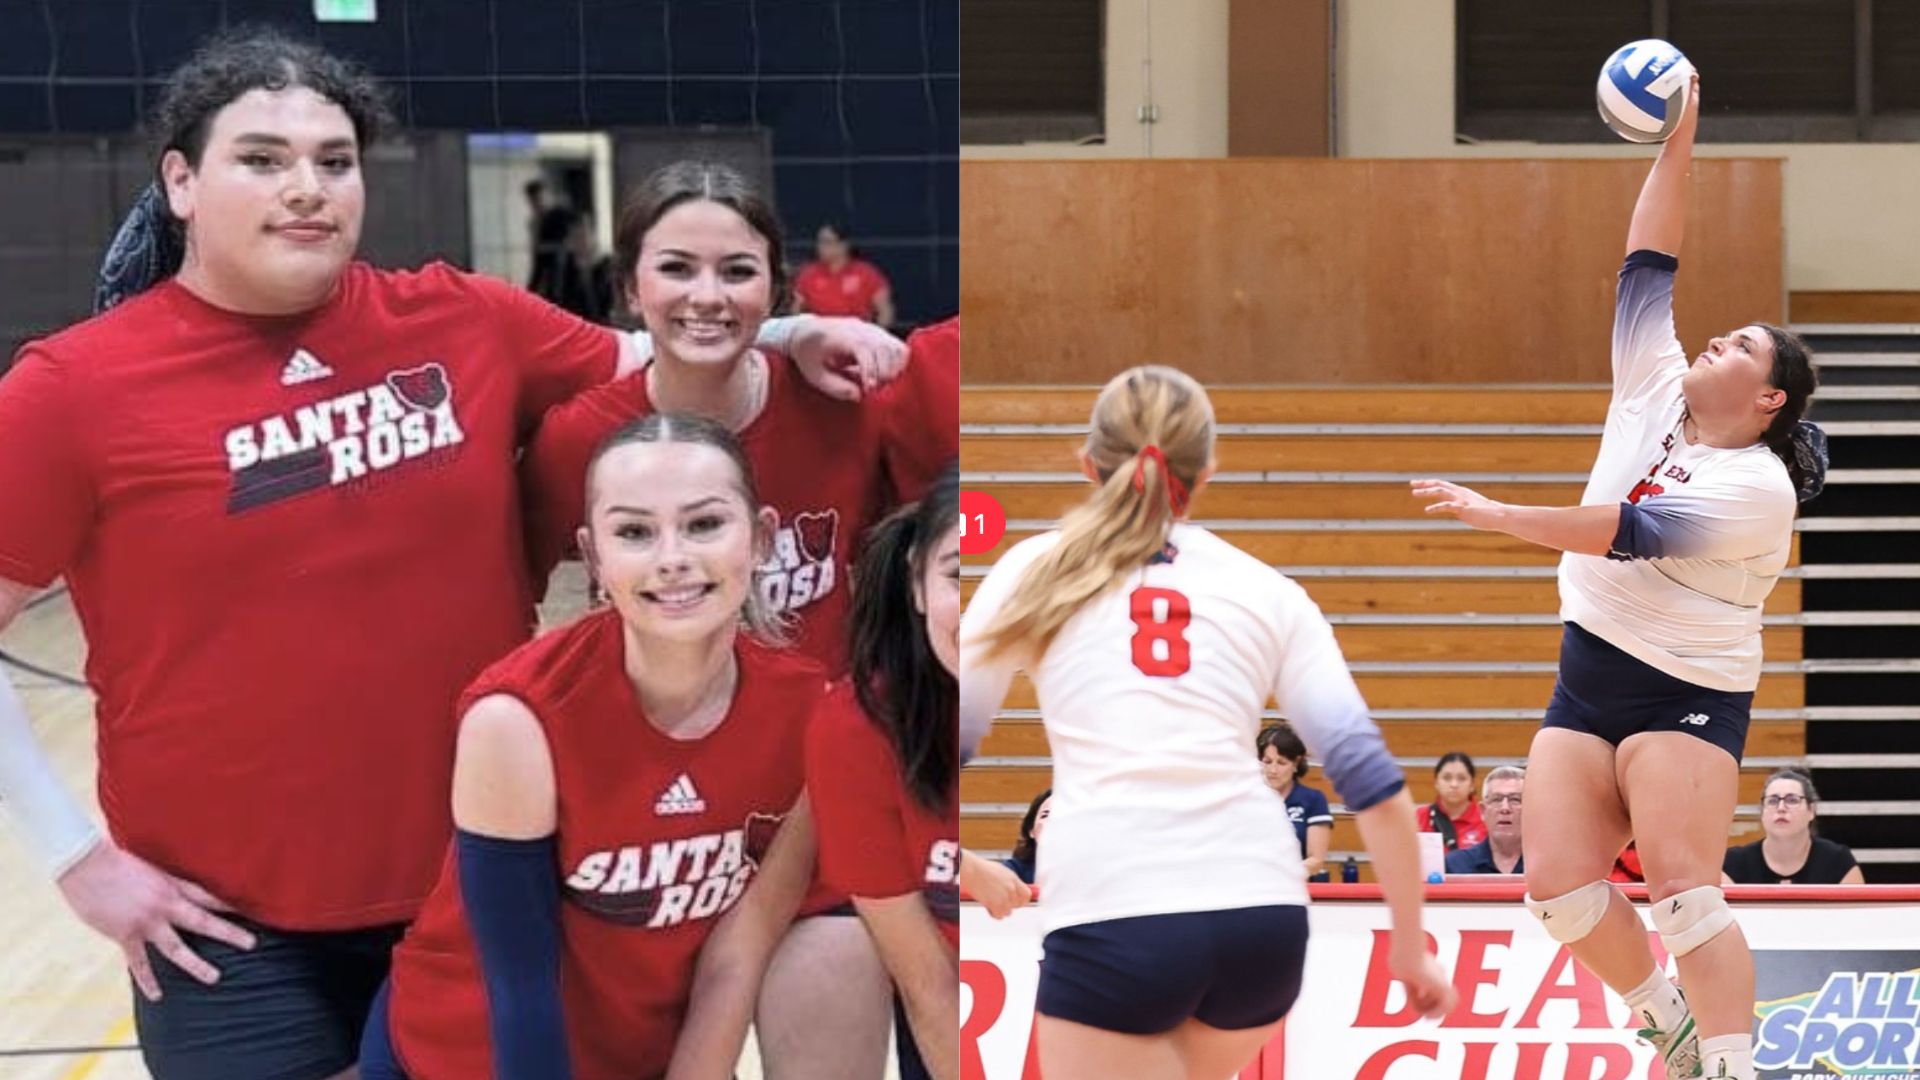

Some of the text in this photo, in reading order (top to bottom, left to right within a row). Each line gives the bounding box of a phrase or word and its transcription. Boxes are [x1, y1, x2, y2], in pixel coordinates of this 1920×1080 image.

[226, 384, 405, 471] SANTA
[328, 400, 464, 485] ROSA
[1129, 586, 1192, 678] 8
[566, 830, 745, 893] SANTA
[1350, 929, 1678, 1029] BEA
[1807, 972, 1920, 1021] ALL
[1752, 1004, 1920, 1070] SPOR
